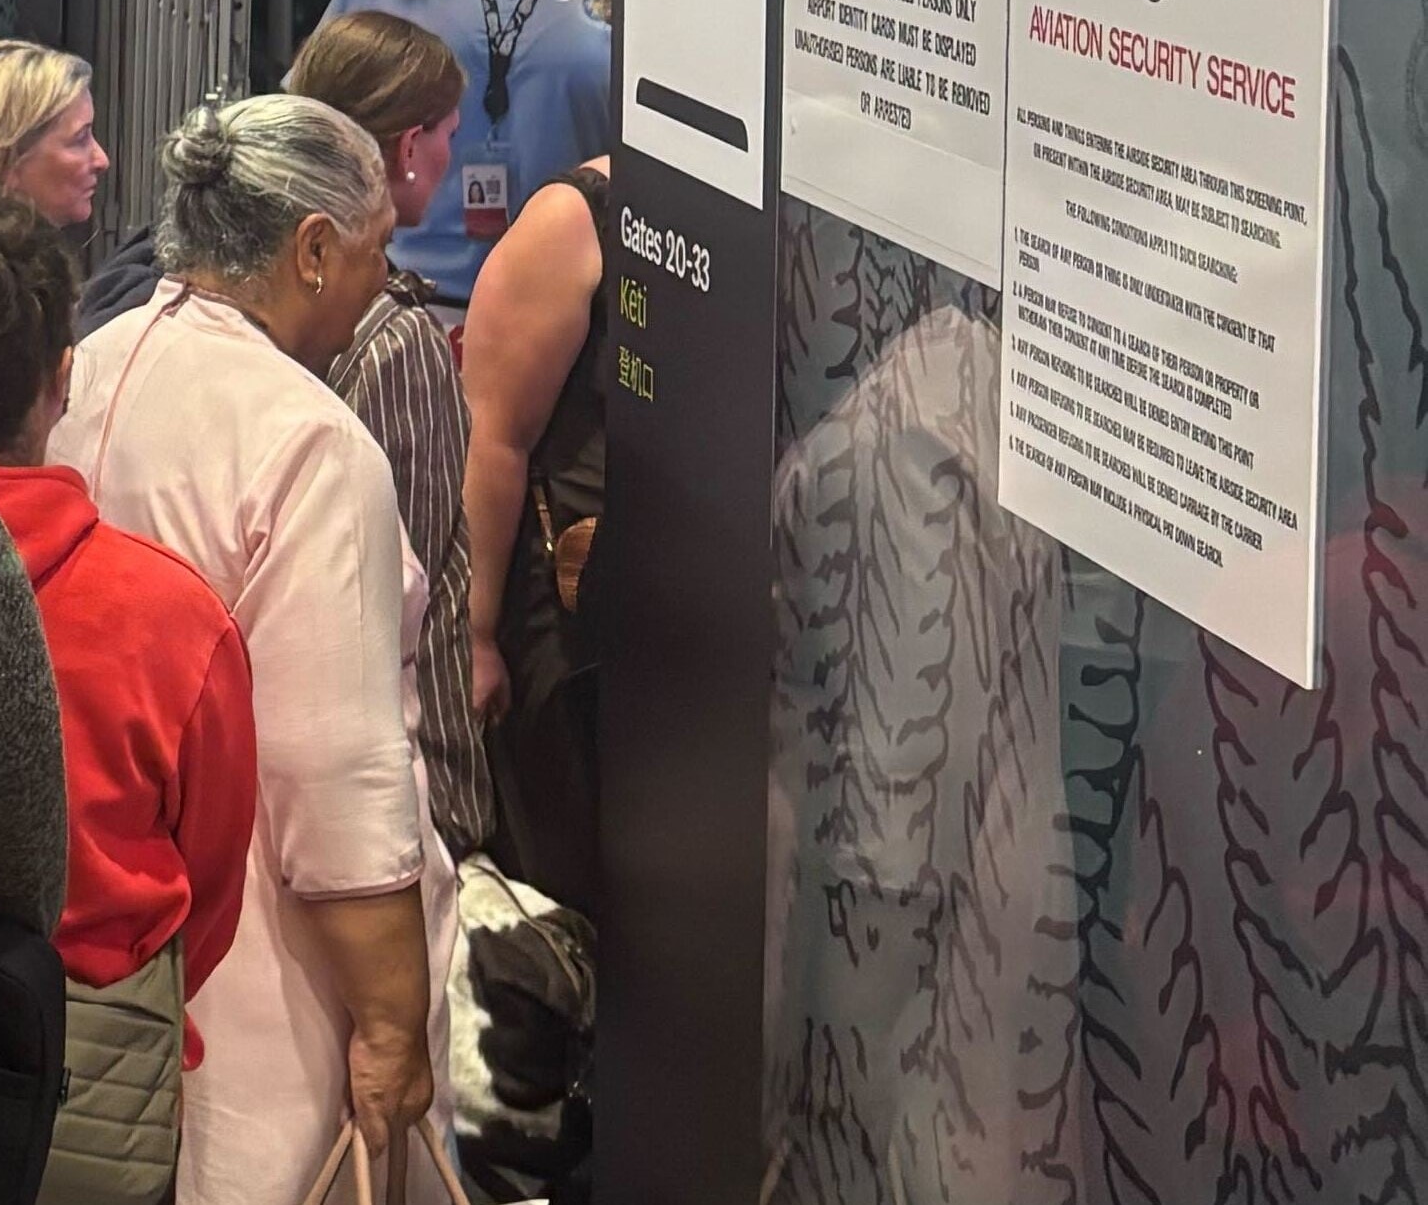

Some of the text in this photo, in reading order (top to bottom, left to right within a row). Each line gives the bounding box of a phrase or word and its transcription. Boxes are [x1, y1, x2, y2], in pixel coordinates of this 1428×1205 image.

[839, 3, 868, 32] IDENTITY
[871, 13, 895, 41] CARDS
[898, 21, 919, 48] MUST
[922, 29, 932, 53] BE
[935, 33, 977, 67] DISPLAYED
[1030, 5, 1297, 119] AVIATION SECURITY SERVICE
[794, 28, 991, 116] UNAUTHORISED PERSONS ARE LIABLE TO BE REMOVED
[860, 91, 912, 130] OR ARRESTED
[620, 206, 711, 293] Gates 20-33
[620, 276, 648, 329] Kēti
[618, 346, 655, 403] 登机口
